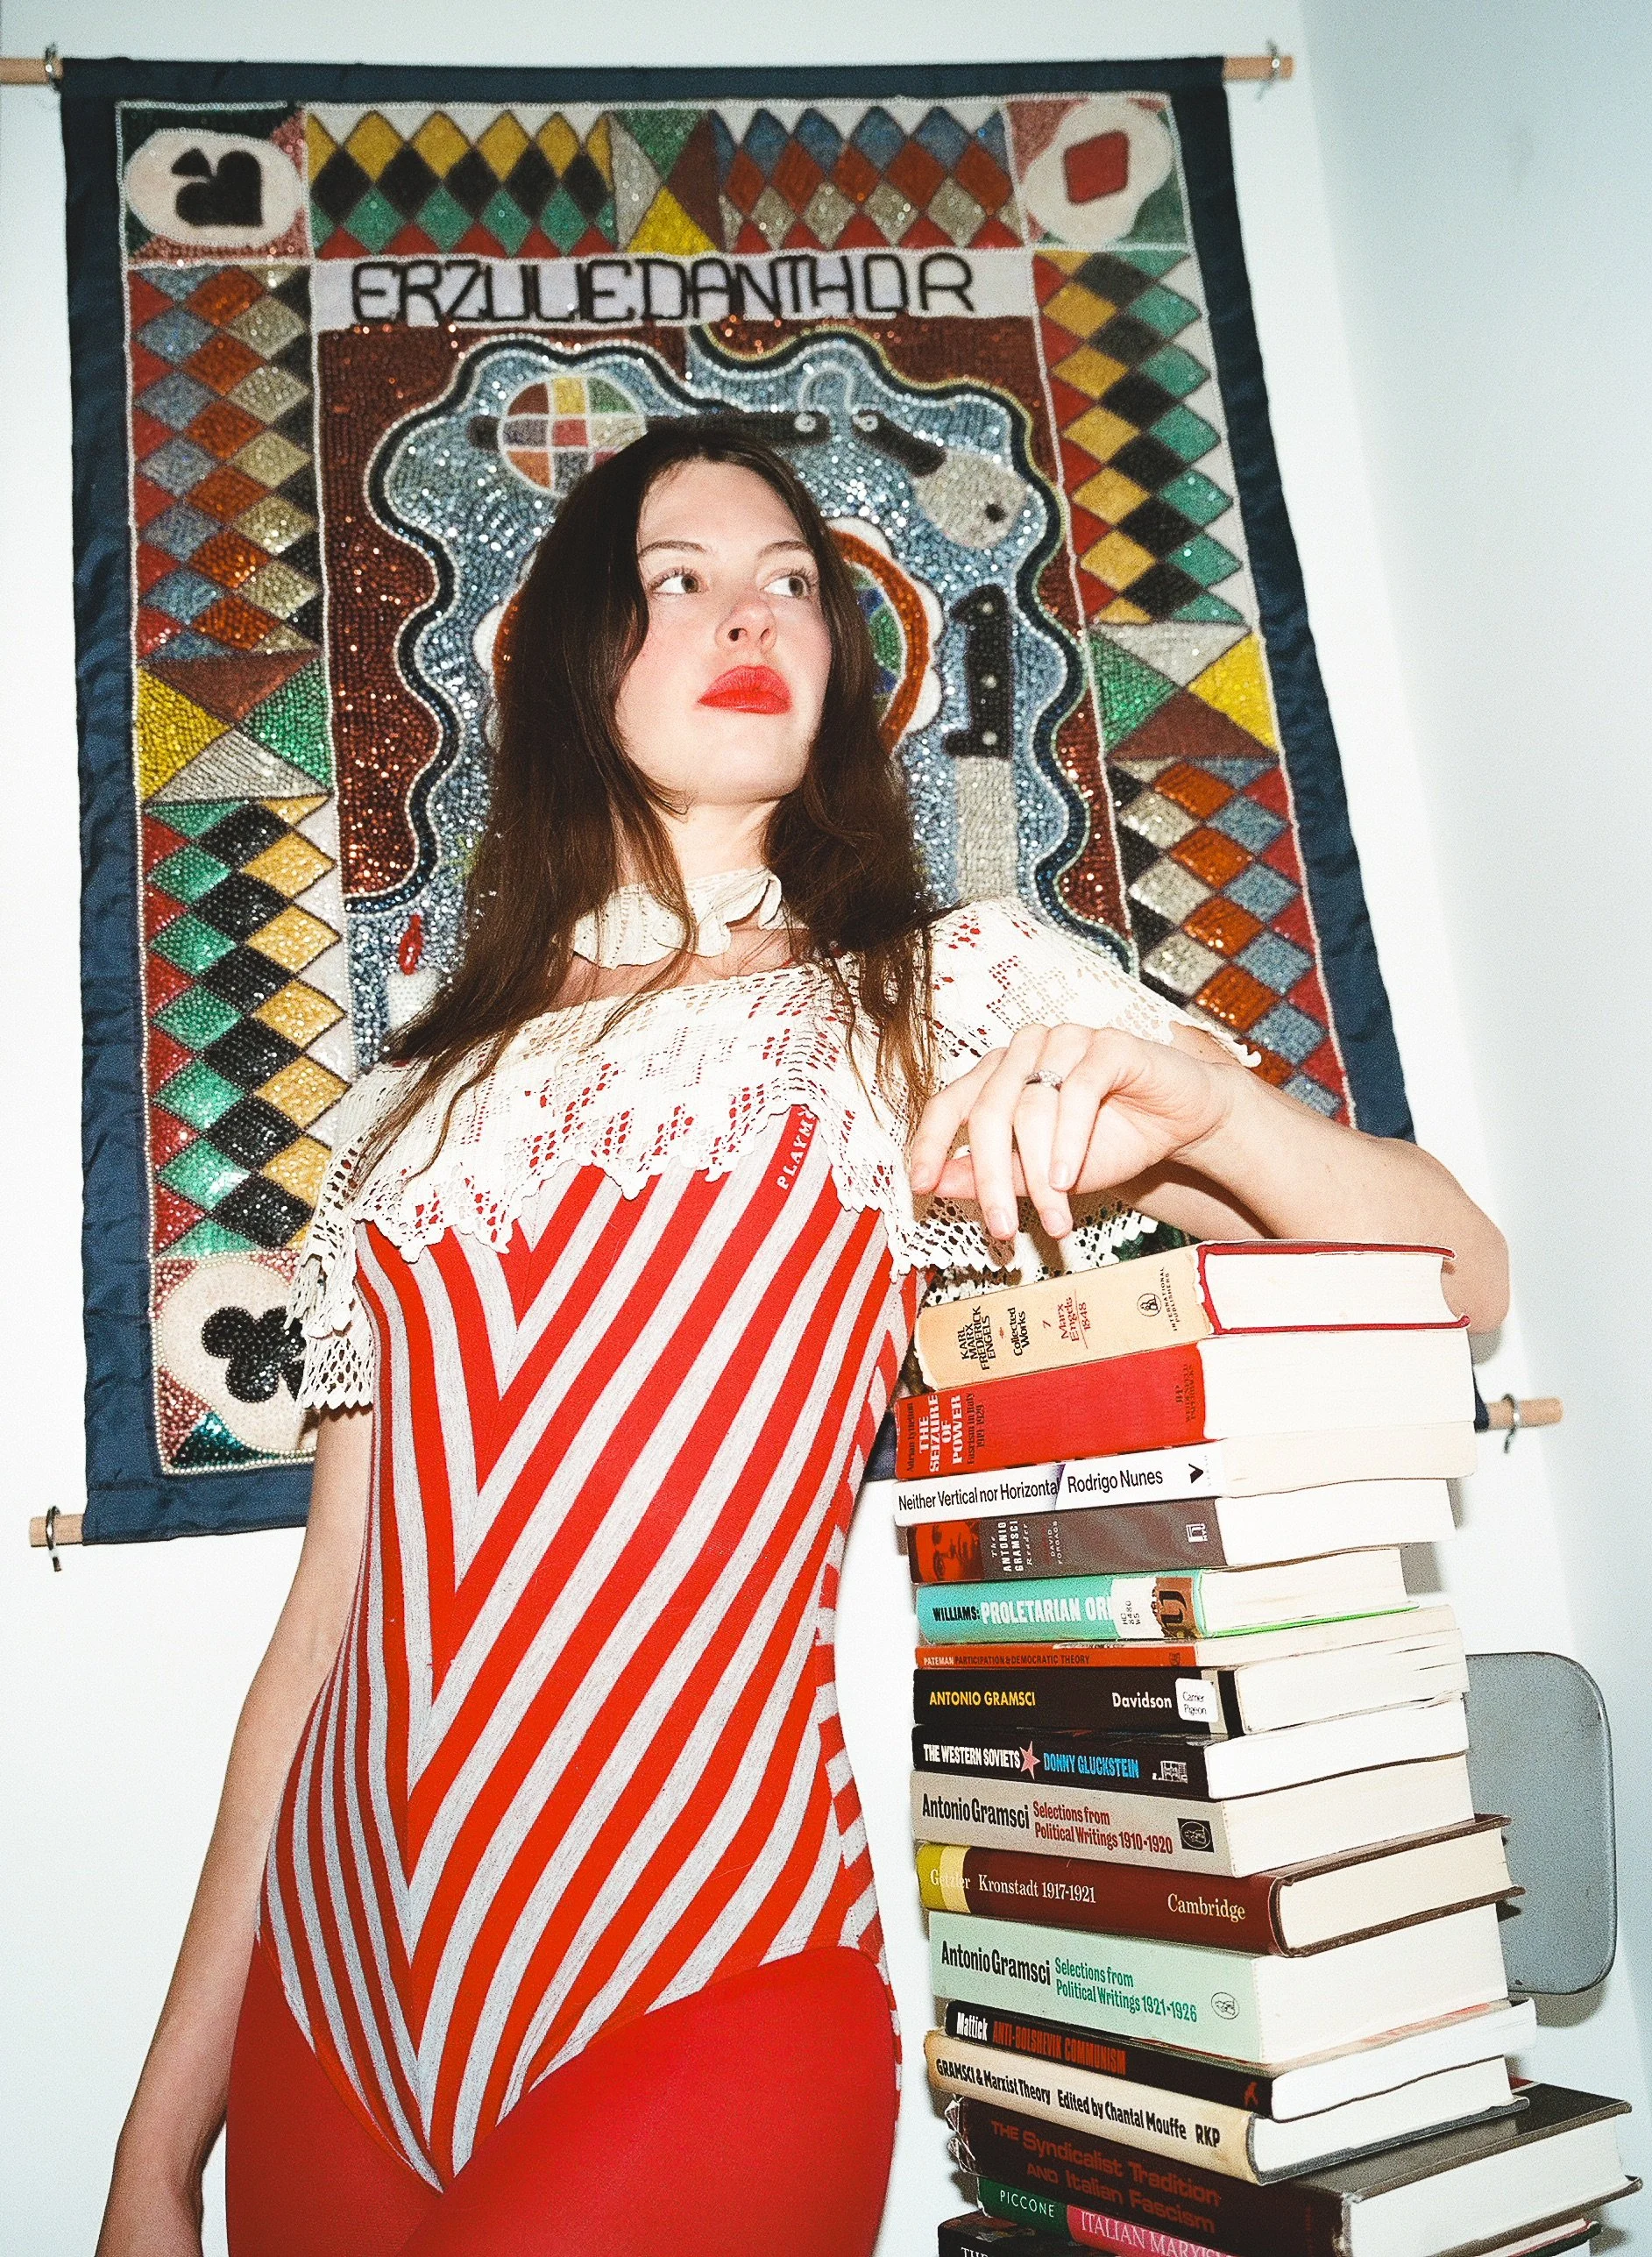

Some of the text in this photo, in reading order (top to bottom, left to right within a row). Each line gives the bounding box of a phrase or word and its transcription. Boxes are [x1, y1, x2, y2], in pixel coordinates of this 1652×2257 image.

[1078, 1302, 1091, 1331] 1848
[1159, 1267, 1178, 1331] INTERNATIONAL
[982, 1315, 996, 1359] ENGELS
[1007, 1307, 1024, 1356] Collected
[1018, 1310, 1030, 1348] Works
[1057, 1303, 1069, 1339] Marx
[1064, 1296, 1080, 1342] Engels
[957, 1326, 970, 1359] KARL
[965, 1323, 979, 1359] MARX
[973, 1306, 990, 1370] FREDERICK
[918, 1416, 929, 1454] THE
[927, 1395, 940, 1473] SEIZURE
[941, 1420, 952, 1444] OF
[950, 1395, 963, 1465] POWER
[898, 1477, 1060, 1511] Neither Vertical nor Horizontal
[1067, 1469, 1163, 1494] Rodrigo Nunes
[997, 1522, 1012, 1572] ANTONIO
[1009, 1521, 1024, 1572] GRAMSCI
[932, 1606, 980, 1622] WILLIAMS:
[981, 1597, 1081, 1625] PROLETARIAN
[924, 1656, 954, 1665] PATEMAN
[954, 1656, 1005, 1664] PARTICIPATION
[1011, 1655, 1059, 1664] DEMOCRATIC
[1060, 1654, 1090, 1664] THEORY
[929, 1691, 1037, 1707] ANTONIO GRAMSCI
[1111, 1691, 1173, 1709] Davidson
[1184, 1704, 1207, 1716] Pigeon
[923, 1743, 1021, 1769] THE WESTERN SOVIETS
[1043, 1752, 1139, 1778] DONNY GLUCKSTEIN
[922, 1793, 1030, 1828] Antonio Gramsci
[1032, 1800, 1110, 1825] Selections from
[1035, 1821, 1173, 1854] Political Writings 1910-1920
[978, 1874, 1039, 1898] Kronstadt
[1041, 1882, 1096, 1904] 1917-1921
[1167, 1892, 1246, 1923] Cambridge
[941, 1941, 1051, 1985] Antonio Gramsci
[1055, 1957, 1134, 1988] Selections from
[1056, 1979, 1197, 2022] Political Writings 1921-1926
[956, 2012, 1127, 2076] Mattick ANTI-BOLSHEVIK COMMUNISM
[936, 2059, 1221, 2147] GRAMSCI & Marxist Theory Edited by Chantal Mouffe RKP
[991, 2120, 1221, 2207] THE Syndicalist Tradition
[1000, 2190, 1055, 2218] PICCONE
[1026, 2163, 1216, 2234] AND Italian Fascism
[1081, 2210, 1147, 2250] ITALIAN
